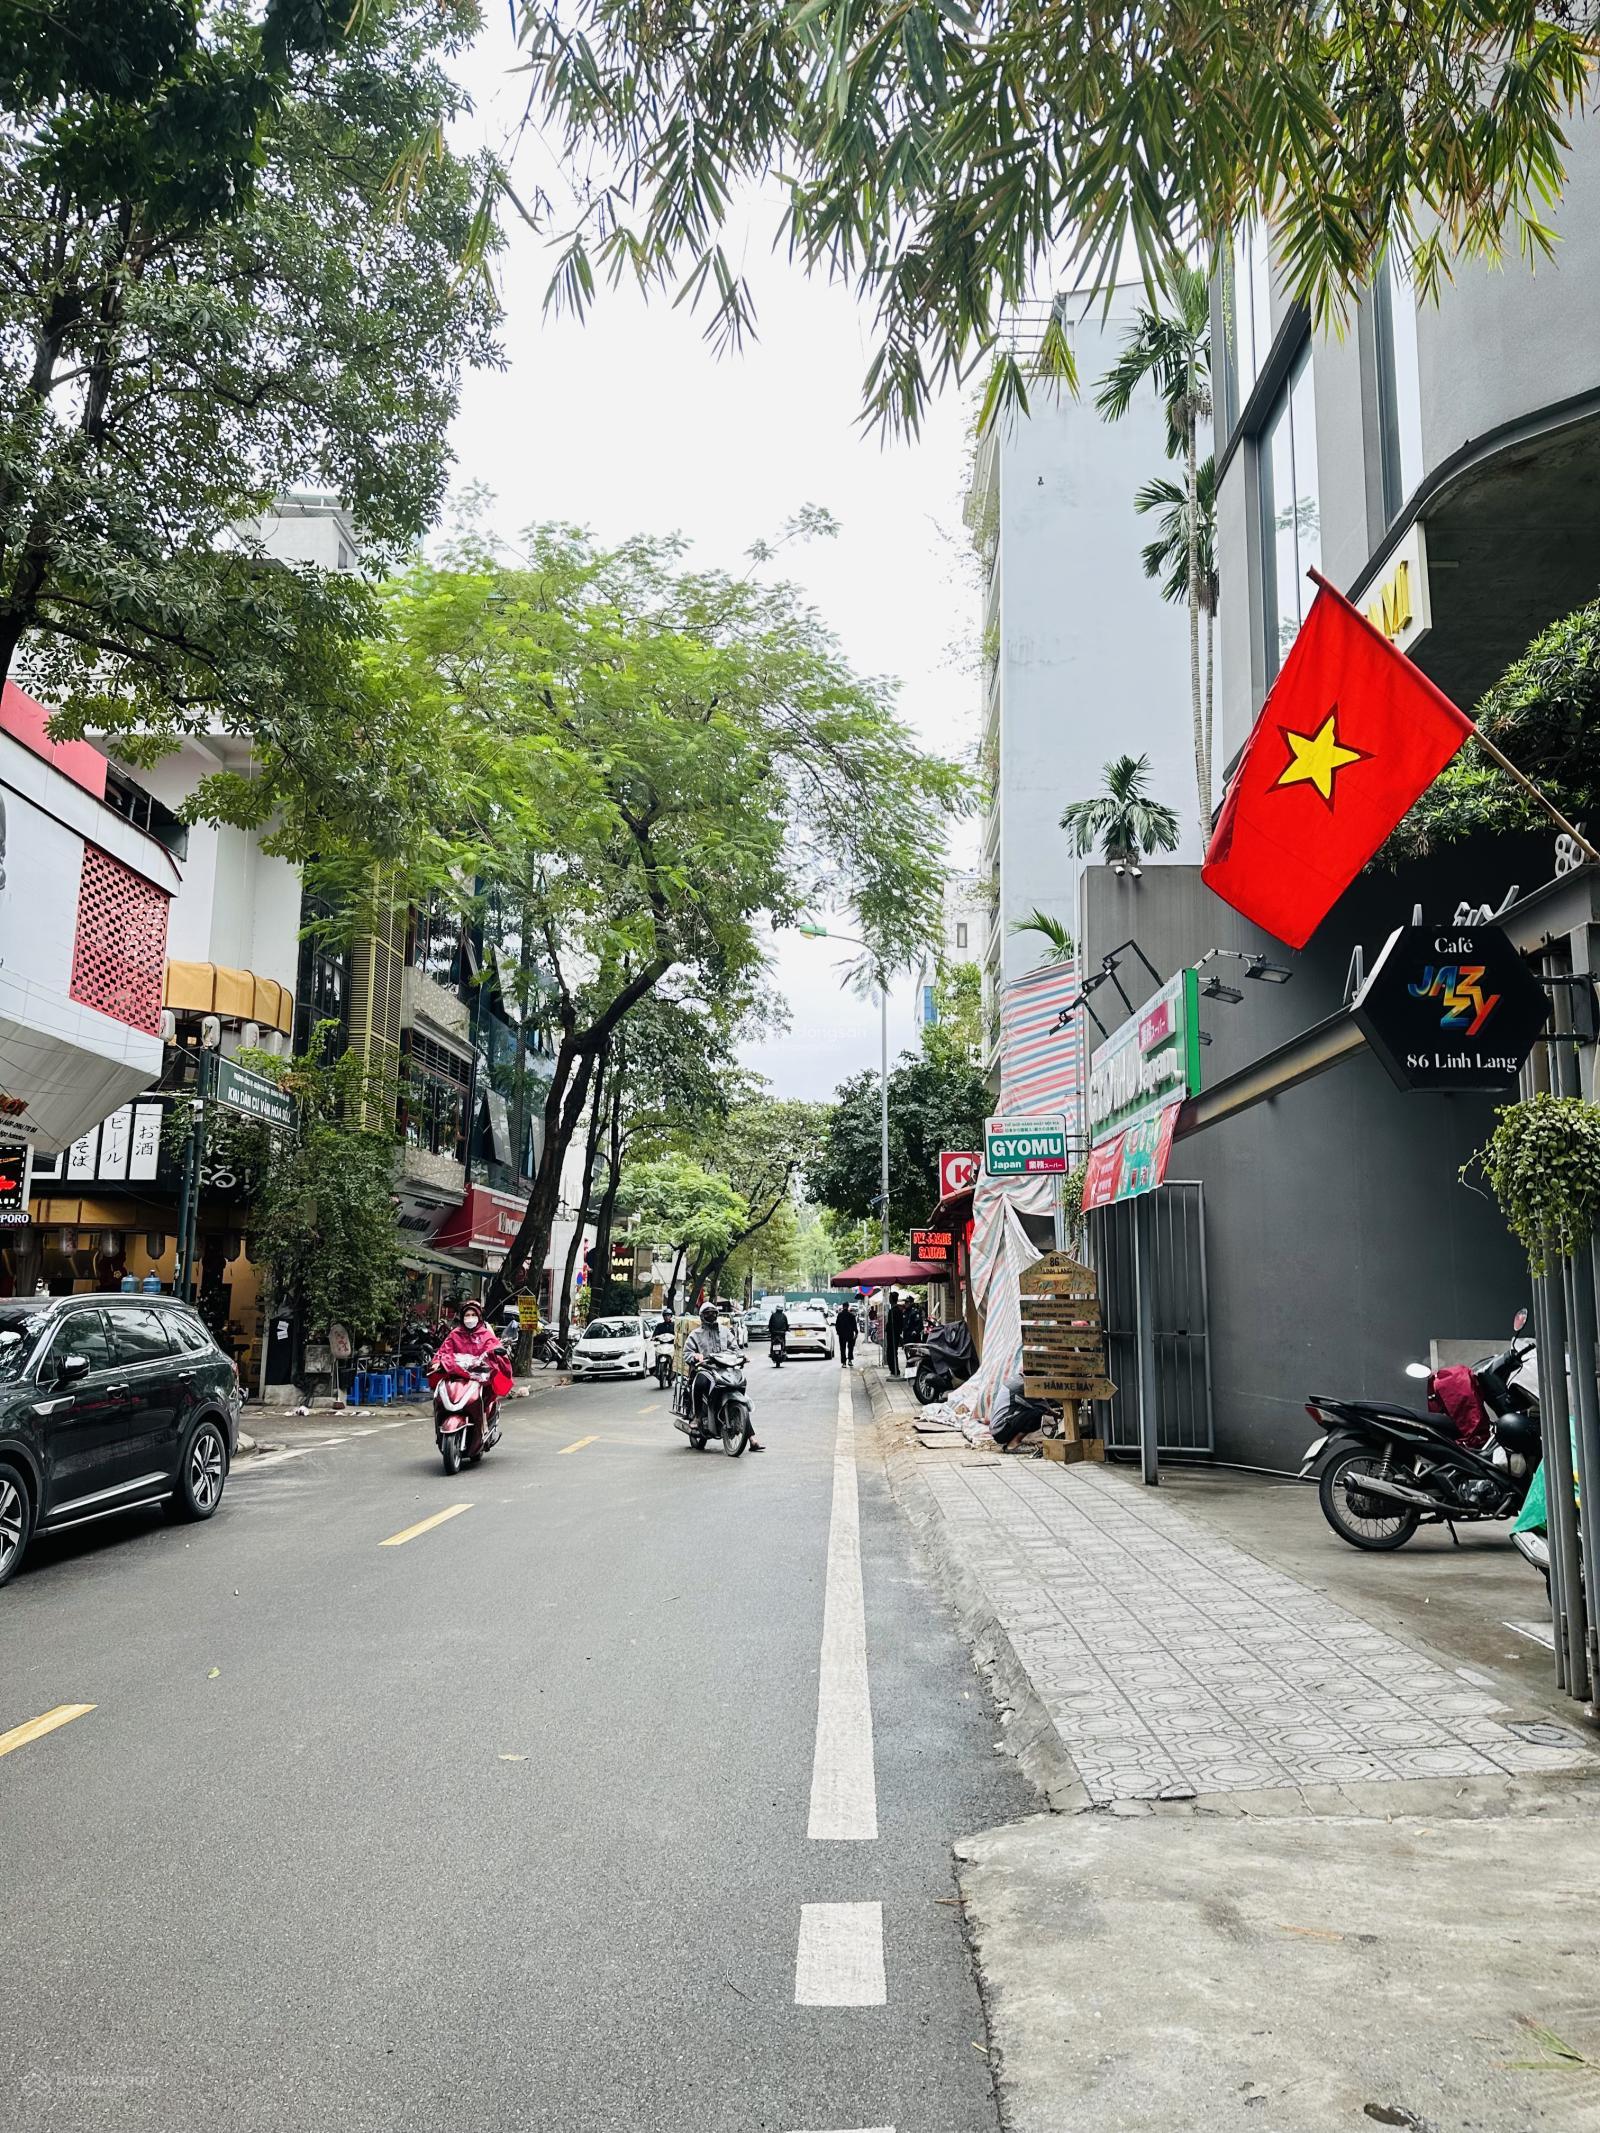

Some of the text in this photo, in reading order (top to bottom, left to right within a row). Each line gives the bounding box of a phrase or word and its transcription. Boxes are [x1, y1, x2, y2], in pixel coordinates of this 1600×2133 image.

[1434, 937, 1473, 953] Café
[1407, 1052, 1518, 1074] 86 Linh Lang
[228, 1086, 240, 1104] KHU
[104, 1116, 127, 1164] ビール
[135, 1125, 160, 1156] お酒
[992, 1138, 1062, 1157] GYOMU
[954, 1164, 972, 1183] K
[993, 1161, 1021, 1170] Japan
[0, 1214, 29, 1224] PORO
[918, 1246, 947, 1259] SAUNA
[1049, 1257, 1060, 1267] 86
[1063, 1381, 1076, 1391] XE
